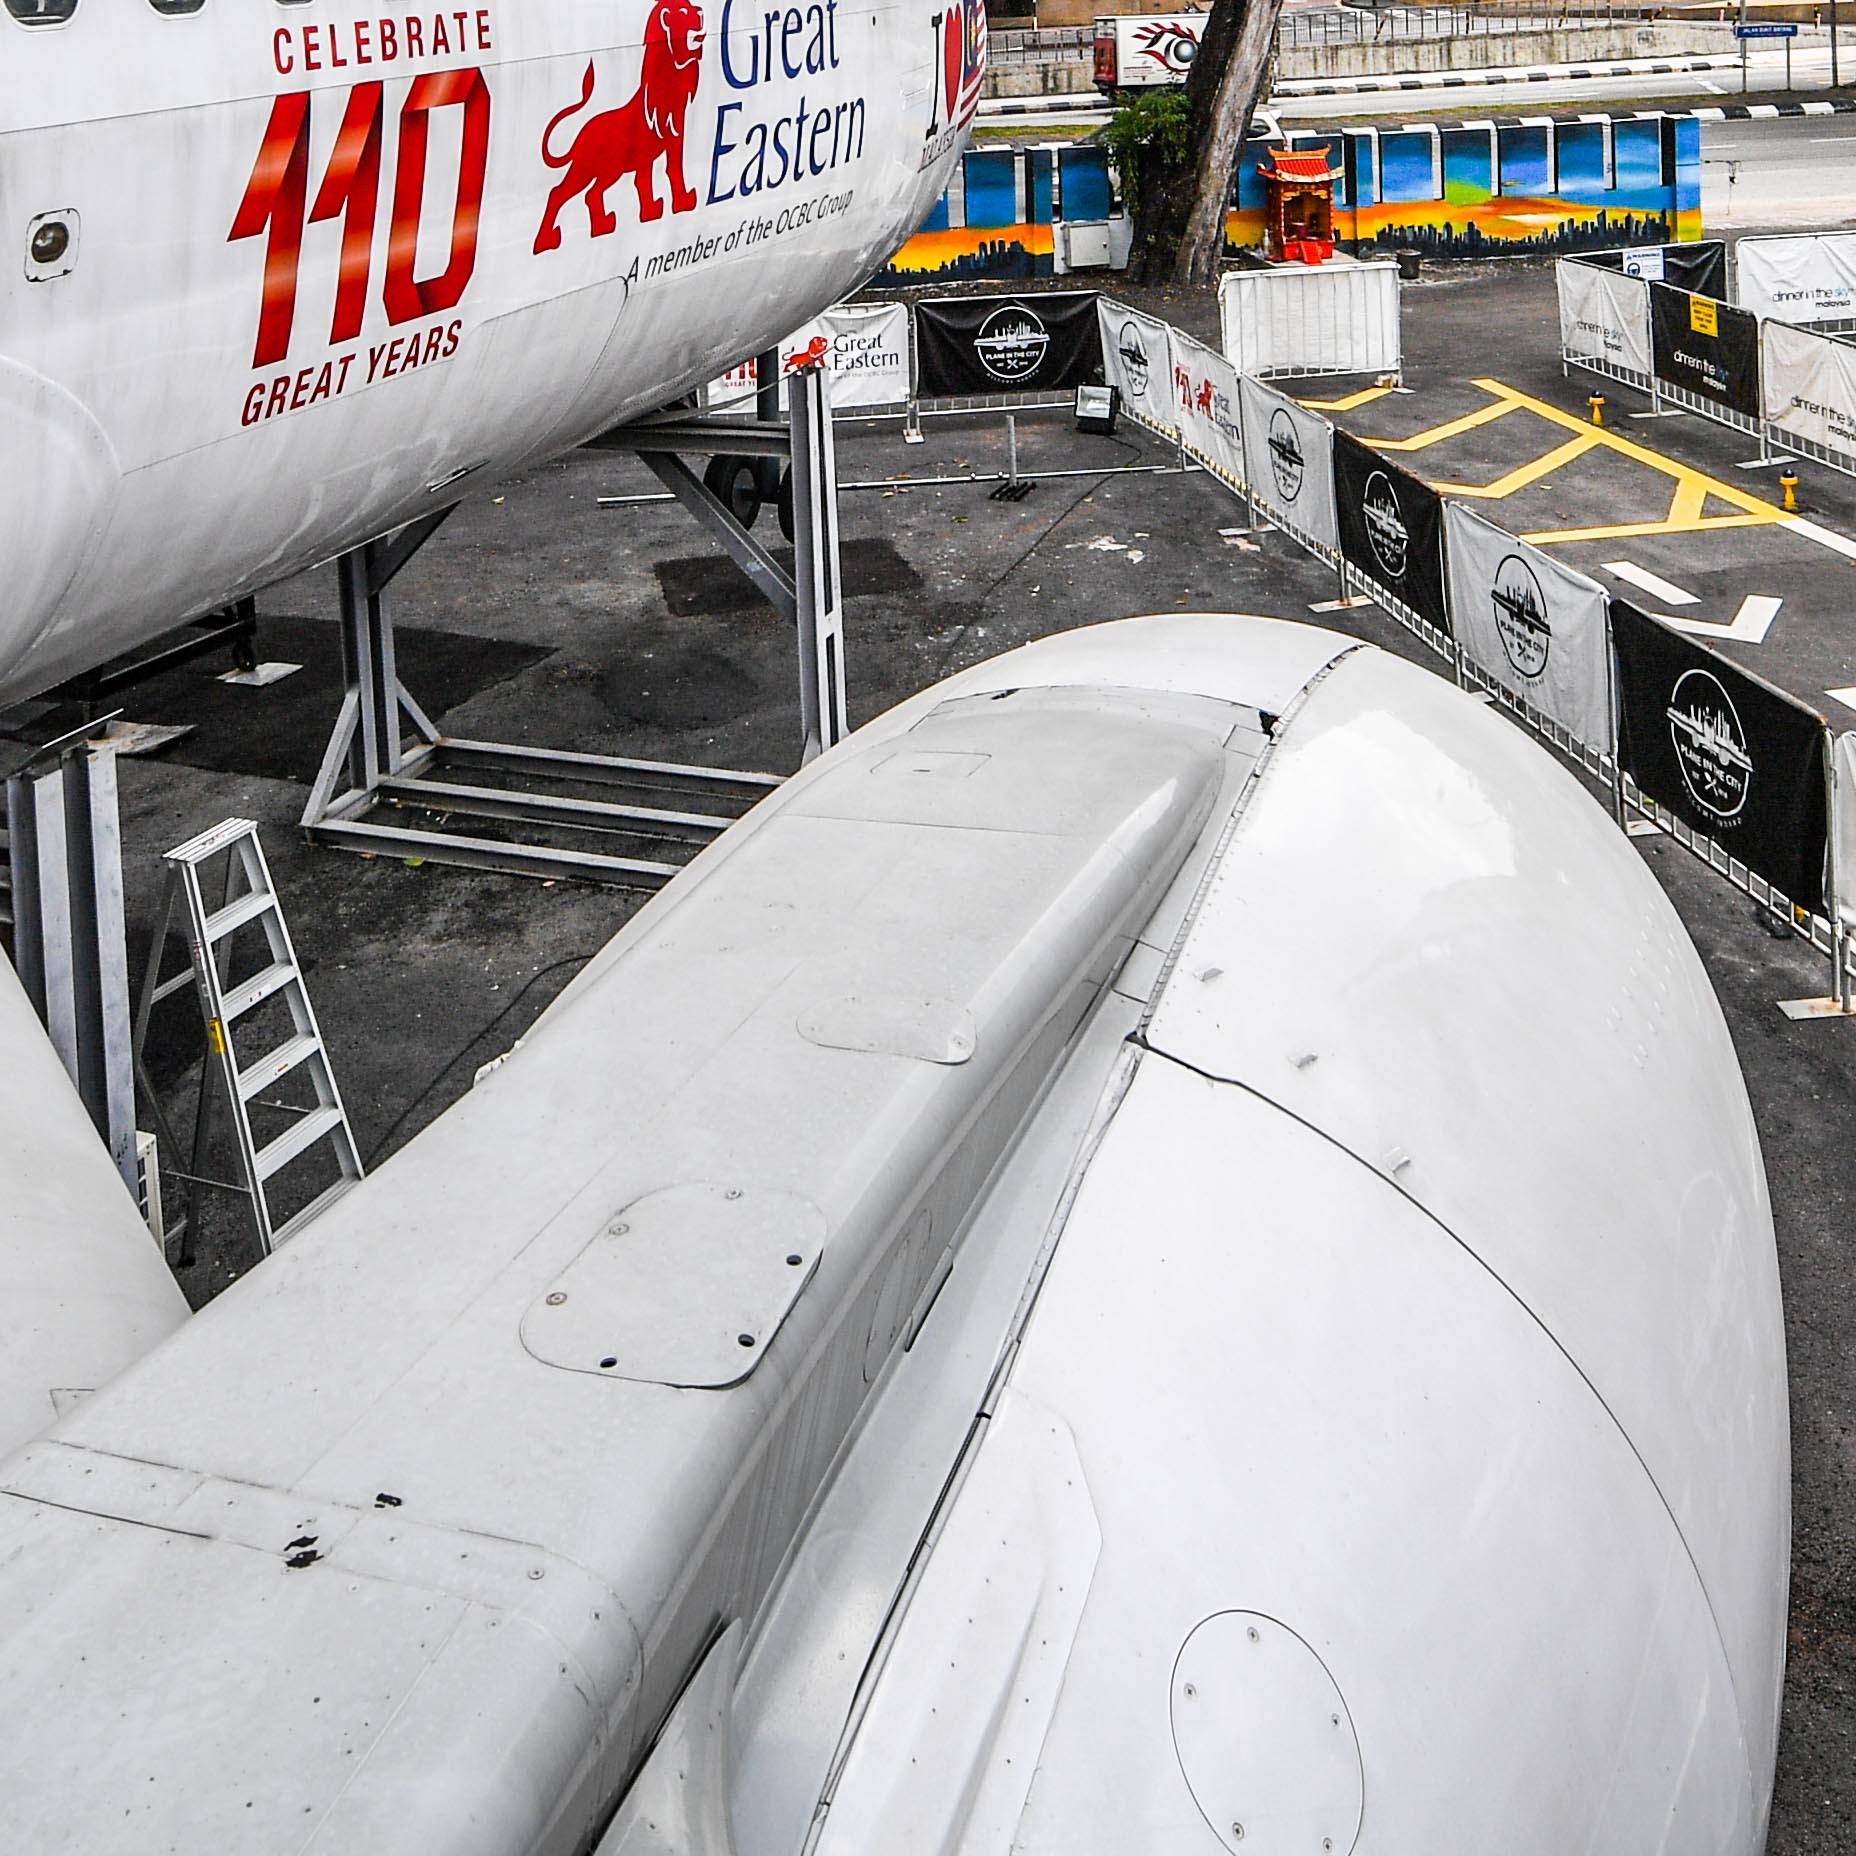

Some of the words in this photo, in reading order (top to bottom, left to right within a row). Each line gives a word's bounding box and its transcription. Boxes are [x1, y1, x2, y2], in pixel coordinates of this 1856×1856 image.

[273, 10, 492, 74] CELEBRATE
[706, 96, 865, 205] Eastern
[227, 67, 491, 369] 110
[626, 256, 639, 284] A
[645, 236, 721, 280] member
[724, 220, 746, 251] of
[747, 216, 773, 245] the
[776, 199, 814, 235] OCBC
[817, 188, 854, 221] Group
[242, 354, 355, 426] GREAT
[366, 320, 462, 384] YEARS
[834, 334, 883, 353] Great
[834, 352, 899, 371] Eastern
